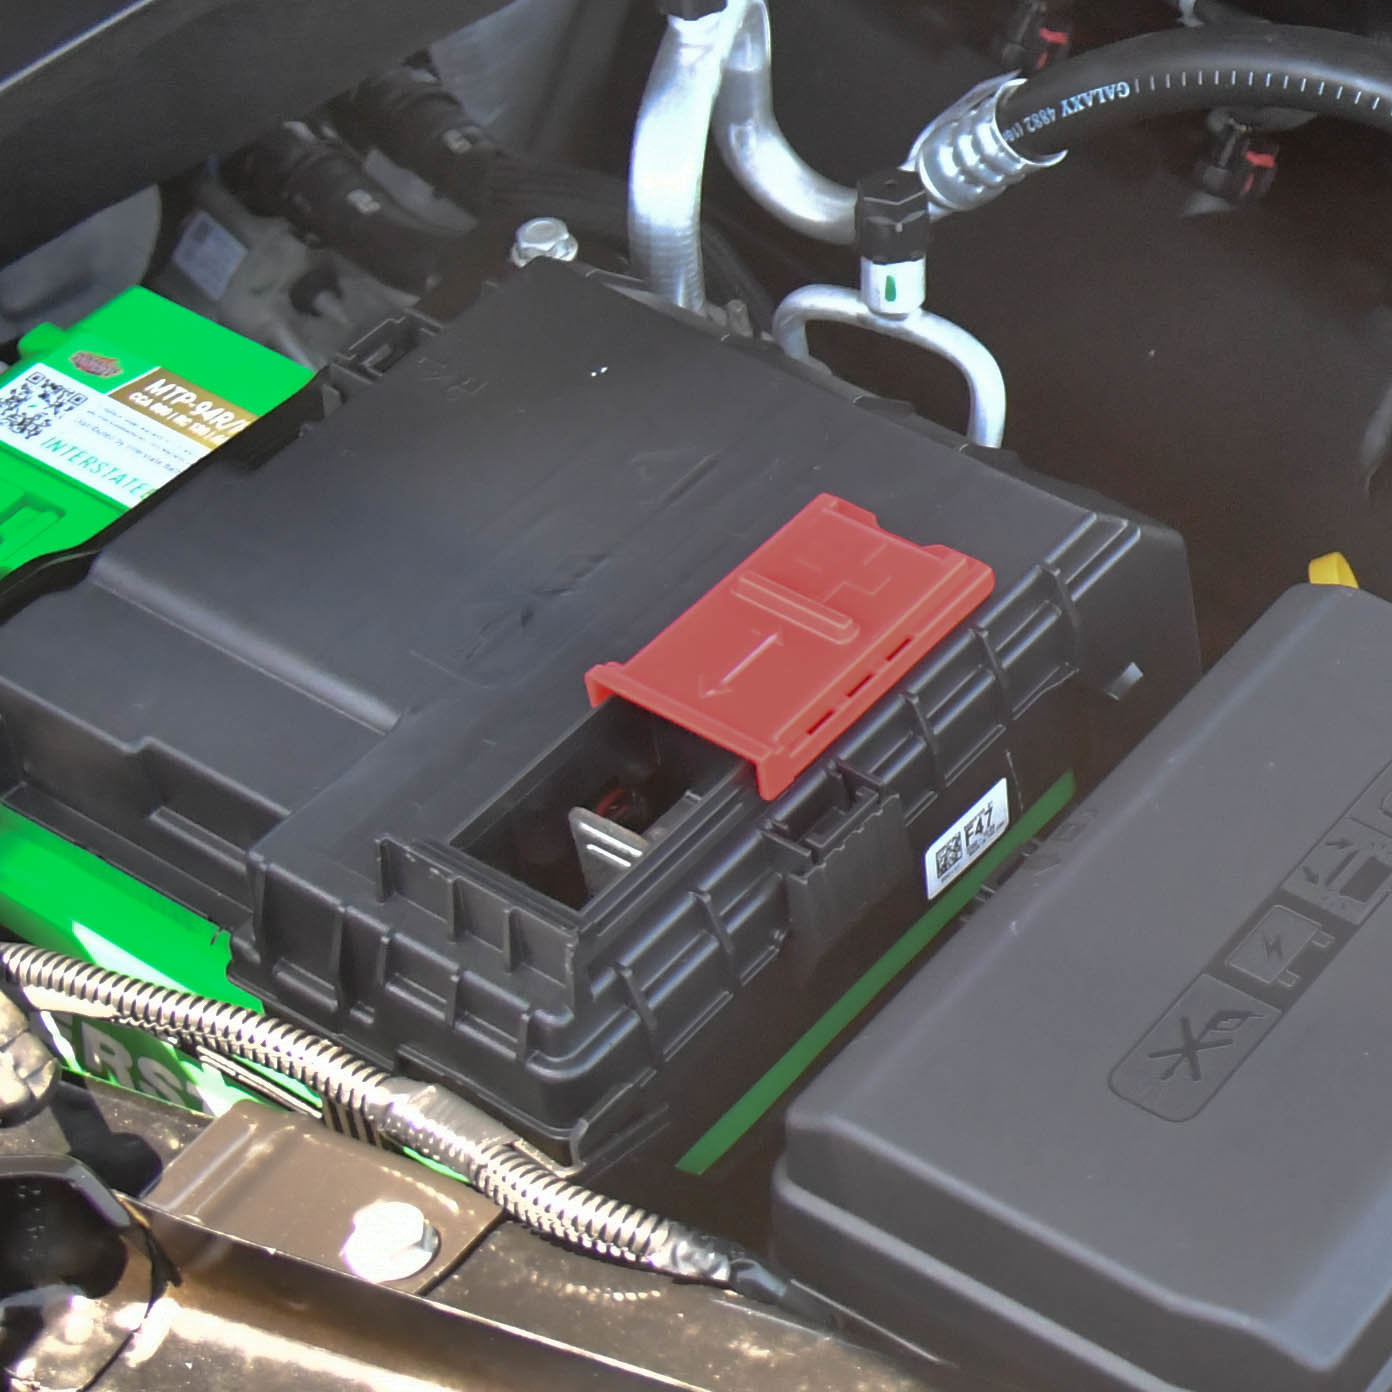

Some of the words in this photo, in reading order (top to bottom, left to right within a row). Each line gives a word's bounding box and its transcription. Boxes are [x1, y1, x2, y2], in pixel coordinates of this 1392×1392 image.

[1060, 81, 1130, 117] GALAXY
[40, 436, 150, 495] INTERSTATE
[963, 805, 994, 848] F47
